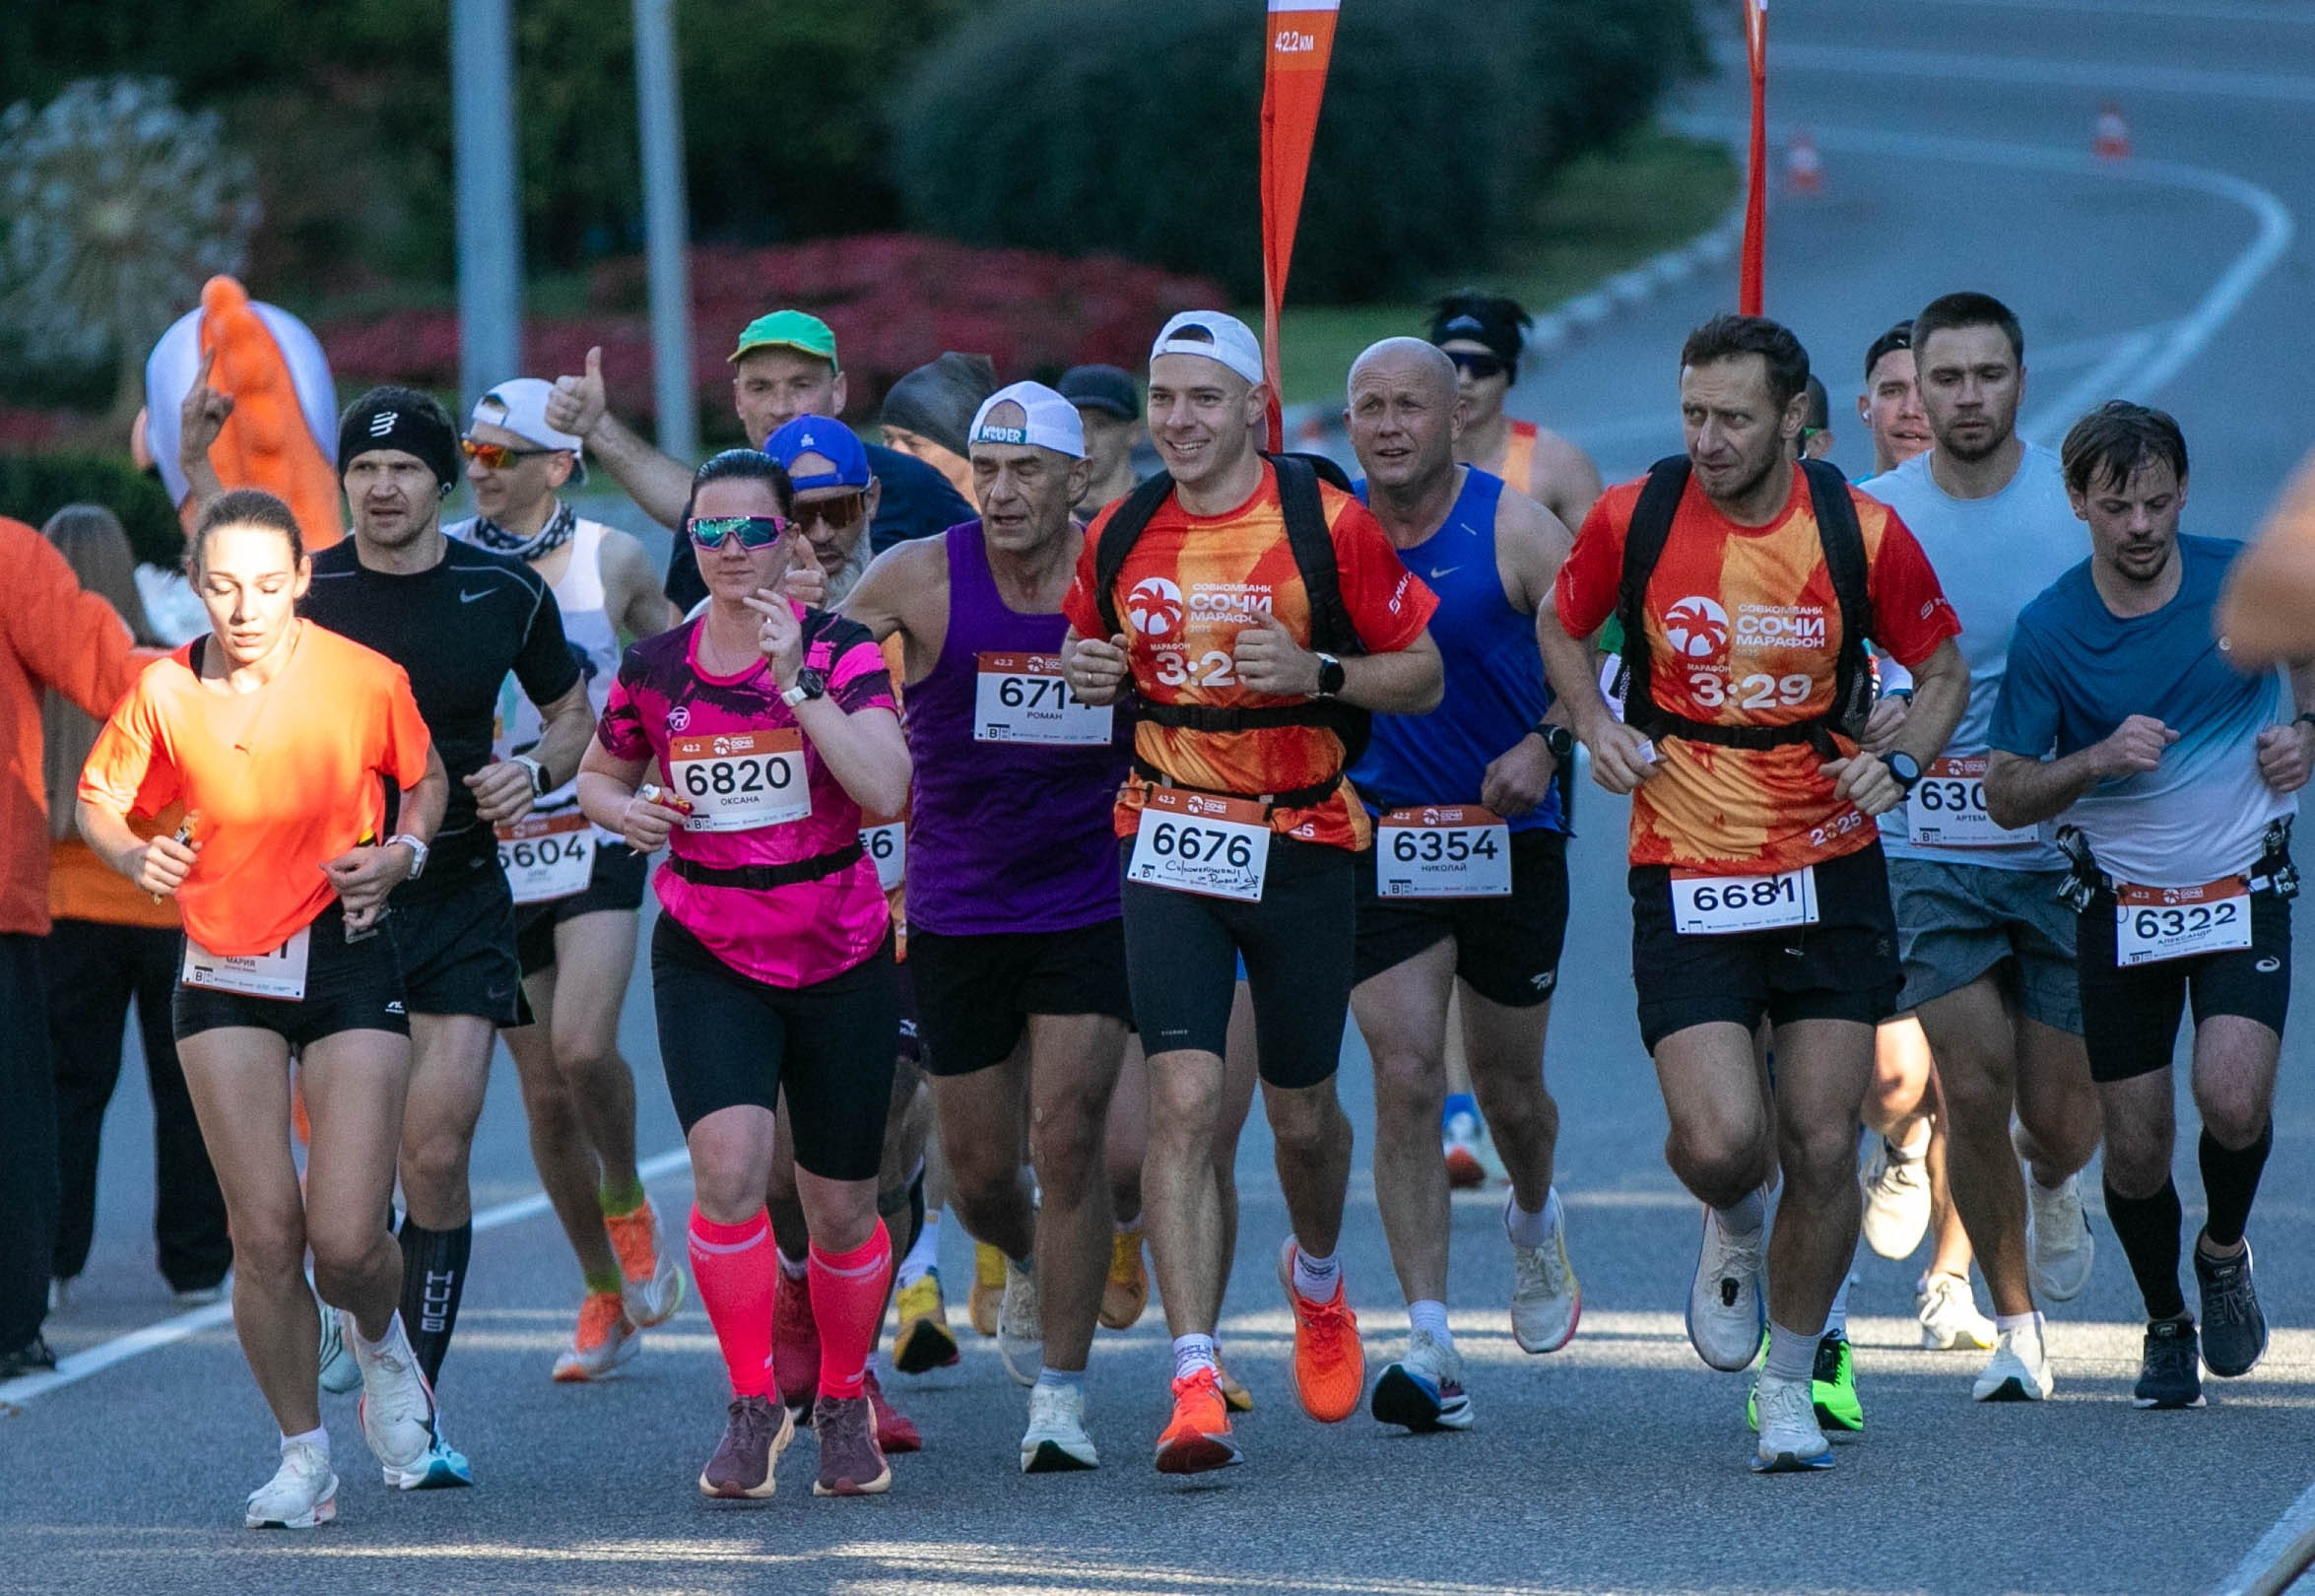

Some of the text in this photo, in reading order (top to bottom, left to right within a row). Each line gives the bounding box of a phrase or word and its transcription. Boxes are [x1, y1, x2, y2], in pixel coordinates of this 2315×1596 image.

[1275, 31, 1299, 52] 42.2
[1192, 582, 1272, 593] СОВКОМБАНК
[1189, 593, 1273, 615] СОЧИ
[1738, 603, 1823, 616] СОВКОМБАНК
[1190, 611, 1259, 625] МАРАФ
[1736, 615, 1825, 637] СОЧИ
[1150, 642, 1191, 651] МАРАФОН
[1736, 634, 1825, 648] МАРАФОН
[1156, 650, 1246, 687] 3:2
[1687, 663, 1732, 673] МАРАФОН
[1688, 672, 1813, 709] 3:29
[1026, 711, 1063, 720] РОМАН
[682, 743, 701, 753] 42.2
[685, 757, 792, 796] 6820
[720, 795, 761, 806] ОКСАНА
[1158, 794, 1176, 805] 42.2
[1920, 781, 1987, 812] 630
[1153, 822, 1253, 867] 6676
[1393, 829, 1498, 862] 6354
[1421, 863, 1467, 873] НИКОЛАЙ
[1692, 877, 1796, 912] 6681
[2131, 891, 2150, 899] 42.2
[2135, 902, 2237, 939] 6322
[2157, 928, 2214, 946] АЛЕКСАНДР
[421, 1270, 454, 1332] HUUB
